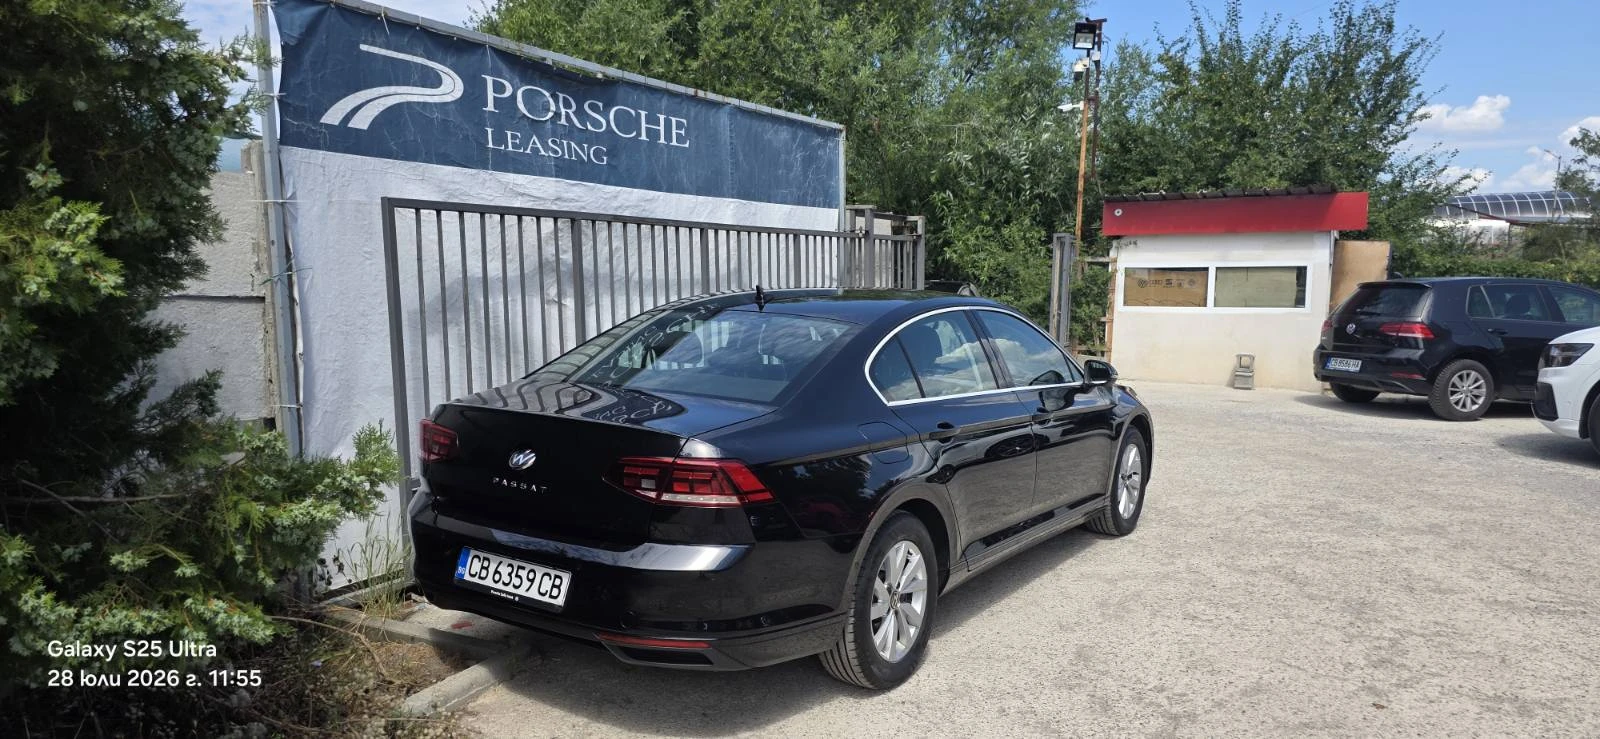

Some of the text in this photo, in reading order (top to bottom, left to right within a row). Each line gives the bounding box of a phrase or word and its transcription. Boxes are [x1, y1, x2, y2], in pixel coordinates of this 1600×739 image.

[481, 74, 690, 148] PORSCHE
[484, 127, 608, 165] LEASING
[492, 477, 548, 494] PASSAT
[468, 554, 564, 600] CB 6359 CB
